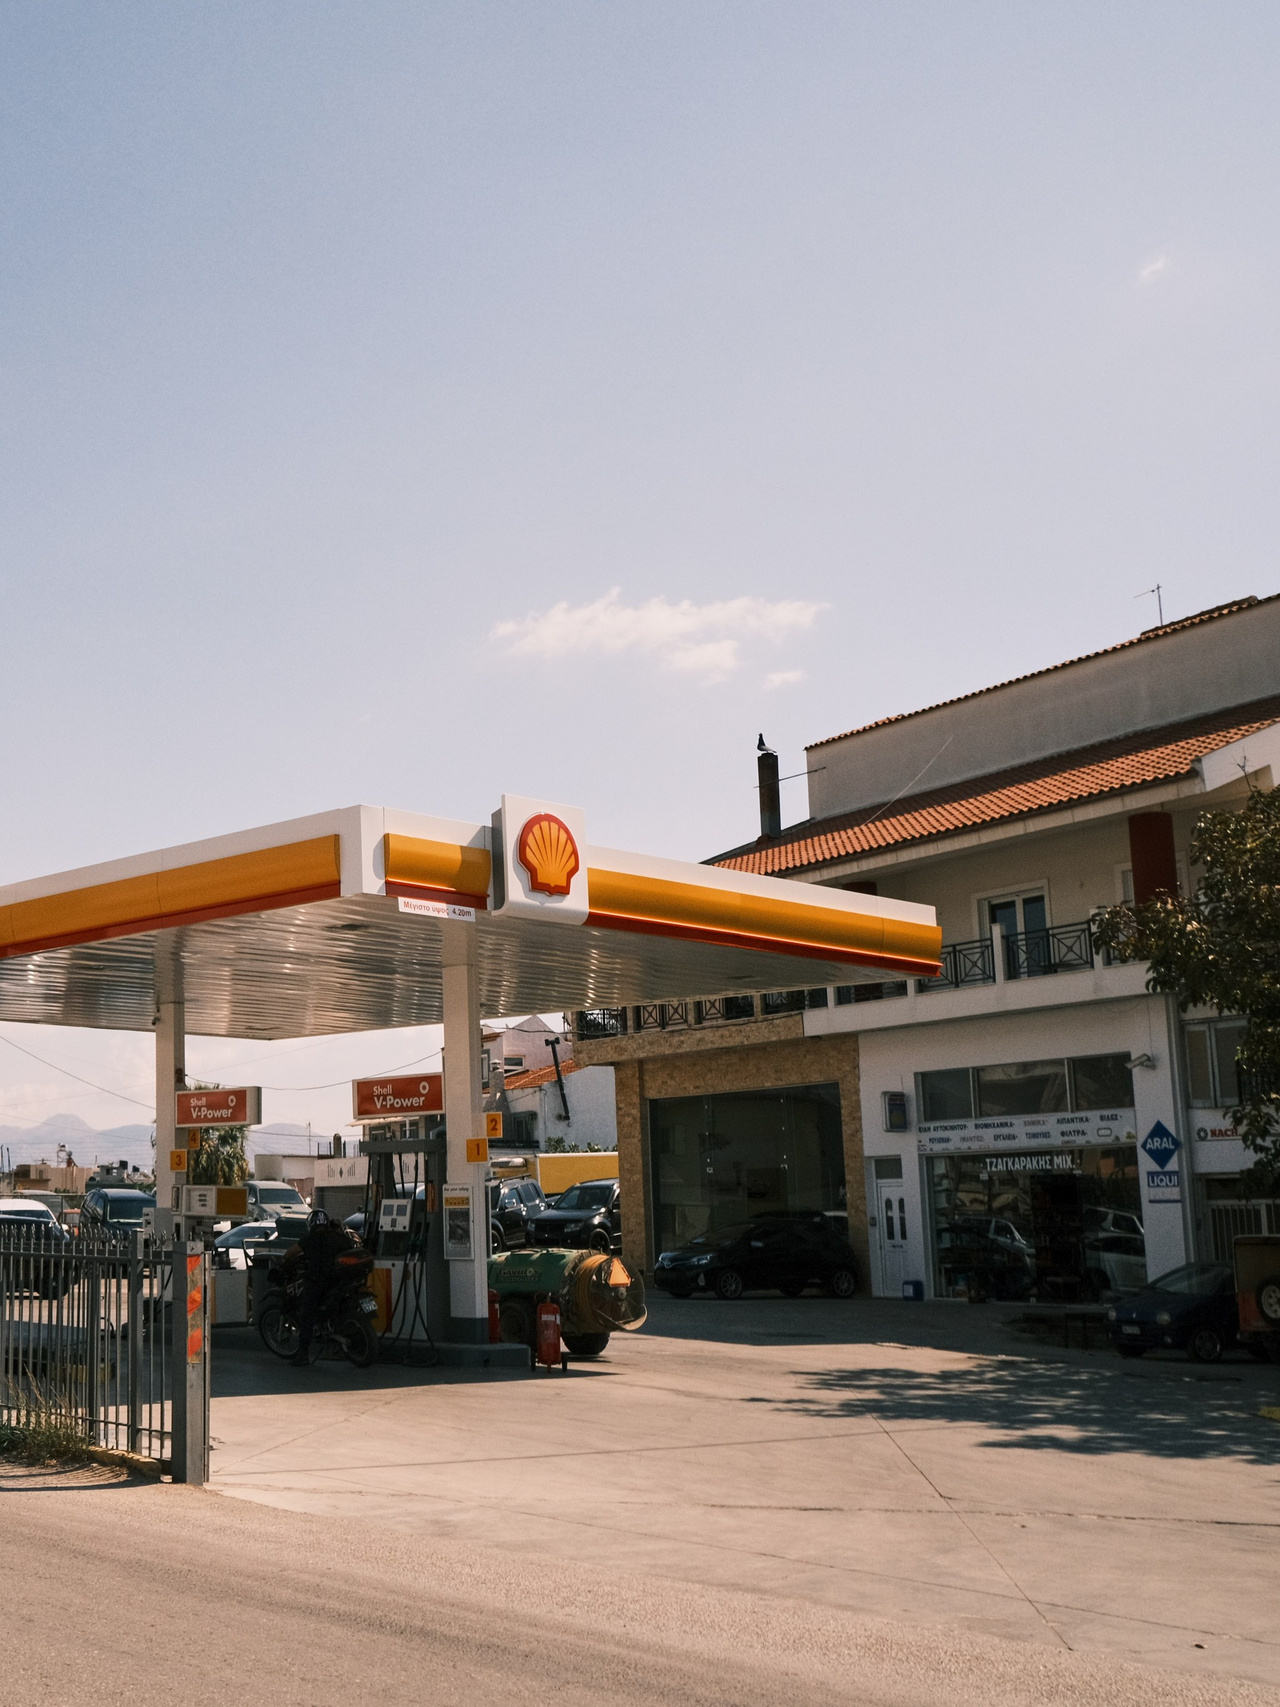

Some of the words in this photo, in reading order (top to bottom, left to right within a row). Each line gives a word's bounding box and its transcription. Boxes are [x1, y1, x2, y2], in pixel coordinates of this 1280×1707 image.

[403, 900, 430, 912] Μέγιστο
[373, 1084, 392, 1096] Shell
[190, 1097, 207, 1107] Shell
[374, 1095, 425, 1109] V-Power
[191, 1107, 233, 1119] V-Power
[490, 1118, 498, 1131] 2
[190, 1132, 196, 1144] 4
[1146, 1137, 1175, 1150] ARAL
[475, 1143, 480, 1156] 1
[176, 1155, 182, 1167] 3
[985, 1156, 1052, 1172] ΤΖΑΓΚΑΡΑΚΗΣ
[1149, 1175, 1178, 1187] LIQUI
